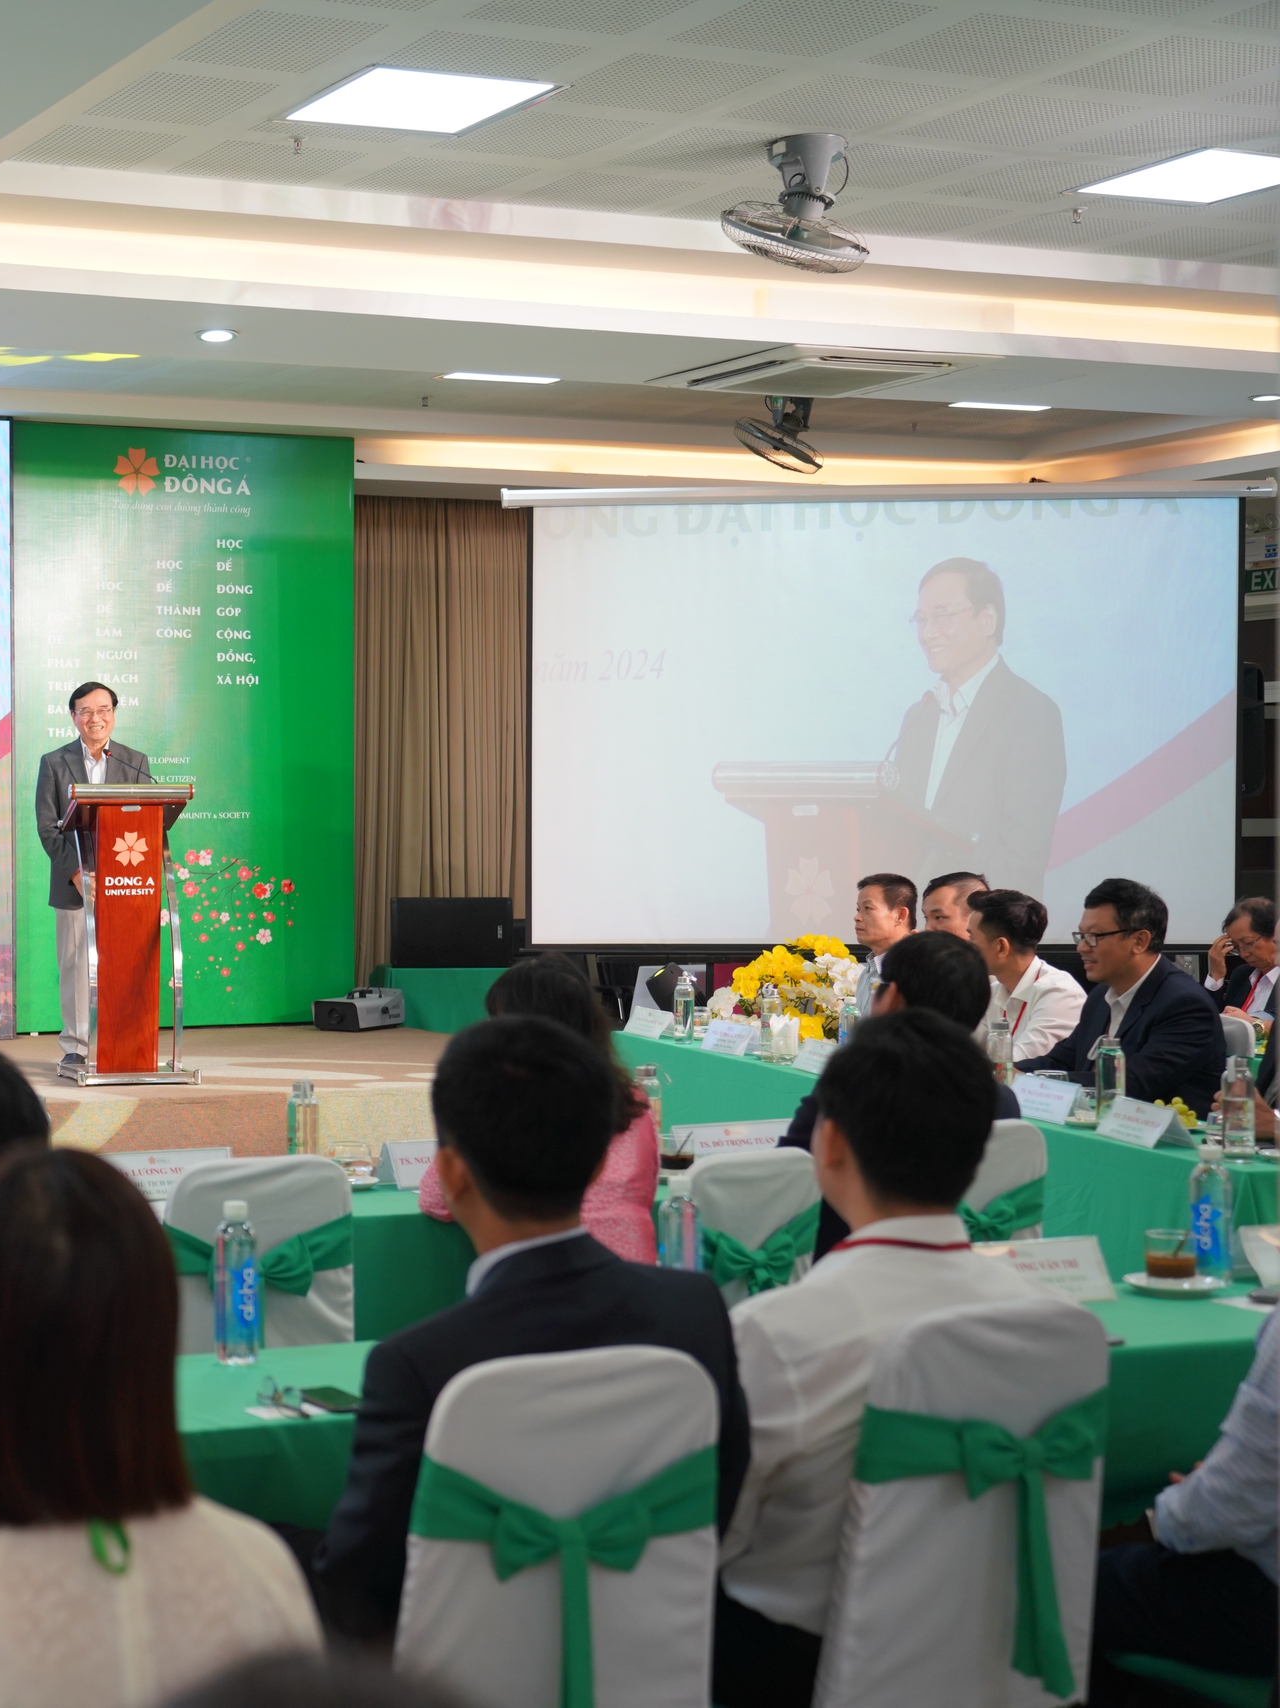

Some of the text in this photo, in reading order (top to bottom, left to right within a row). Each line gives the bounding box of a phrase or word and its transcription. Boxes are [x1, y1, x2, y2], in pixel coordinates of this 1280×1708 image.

[164, 454, 240, 473] ĐẠI HỌC
[164, 473, 251, 495] ĐÔNG Á
[203, 502, 228, 513] thành
[230, 505, 251, 517] công
[216, 539, 243, 551] HỌC
[156, 560, 184, 572] HỌC
[96, 581, 124, 593] HỌC
[216, 582, 254, 595] ĐÓNG
[156, 604, 201, 616] THÀNH
[216, 605, 242, 617] GÓP
[156, 627, 192, 639] CÔNG
[216, 627, 251, 642] CỘNG
[96, 649, 138, 661] NGƯỜI
[598, 648, 666, 682] 2024
[96, 671, 139, 683] TRÁCH
[217, 673, 260, 687] XÃ HỘI
[147, 756, 191, 764] ELOPMENT
[166, 775, 197, 783] CITIZEN
[218, 811, 251, 819] SOCIETY
[105, 876, 155, 886] DONG A
[105, 888, 155, 896] UNIVERSITY
